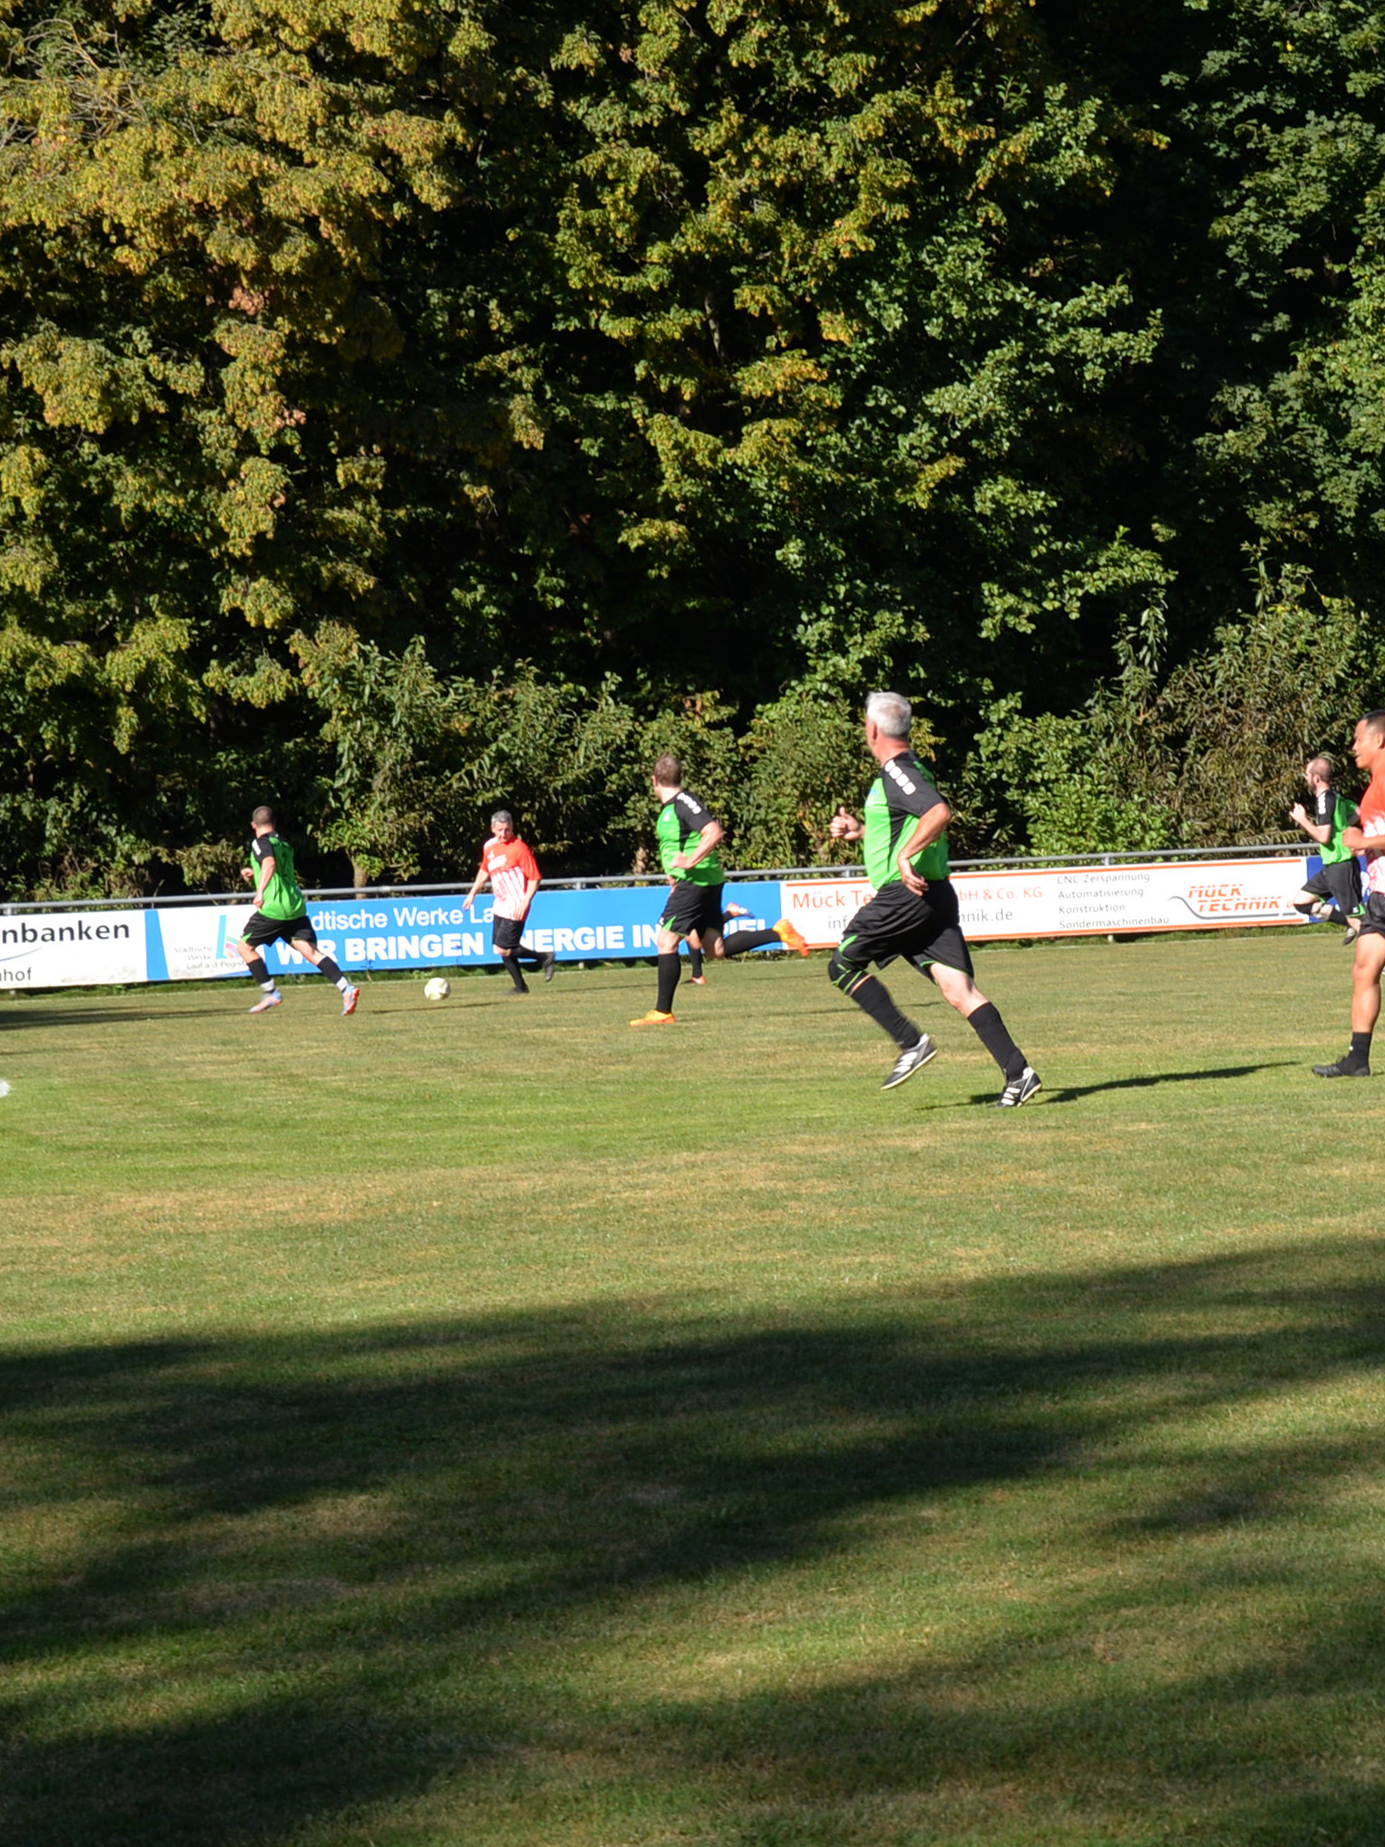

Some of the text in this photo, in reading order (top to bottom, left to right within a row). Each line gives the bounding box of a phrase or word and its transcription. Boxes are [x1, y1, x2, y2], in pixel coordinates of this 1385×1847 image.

[1057, 873, 1150, 885] CNC-Zerspannung
[793, 890, 846, 909] Mück
[983, 888, 992, 900] &
[996, 887, 1018, 900] Co.
[1023, 886, 1043, 898] KG
[1058, 888, 1144, 899] Automatisierung
[1059, 903, 1126, 914] Konstruktion
[1198, 896, 1283, 912] TECHNIK
[393, 906, 463, 927] Werke
[1060, 916, 1170, 929] Sondermaschinenbau
[345, 932, 483, 962] BRINGEN
[494, 926, 624, 955] NERGIE
